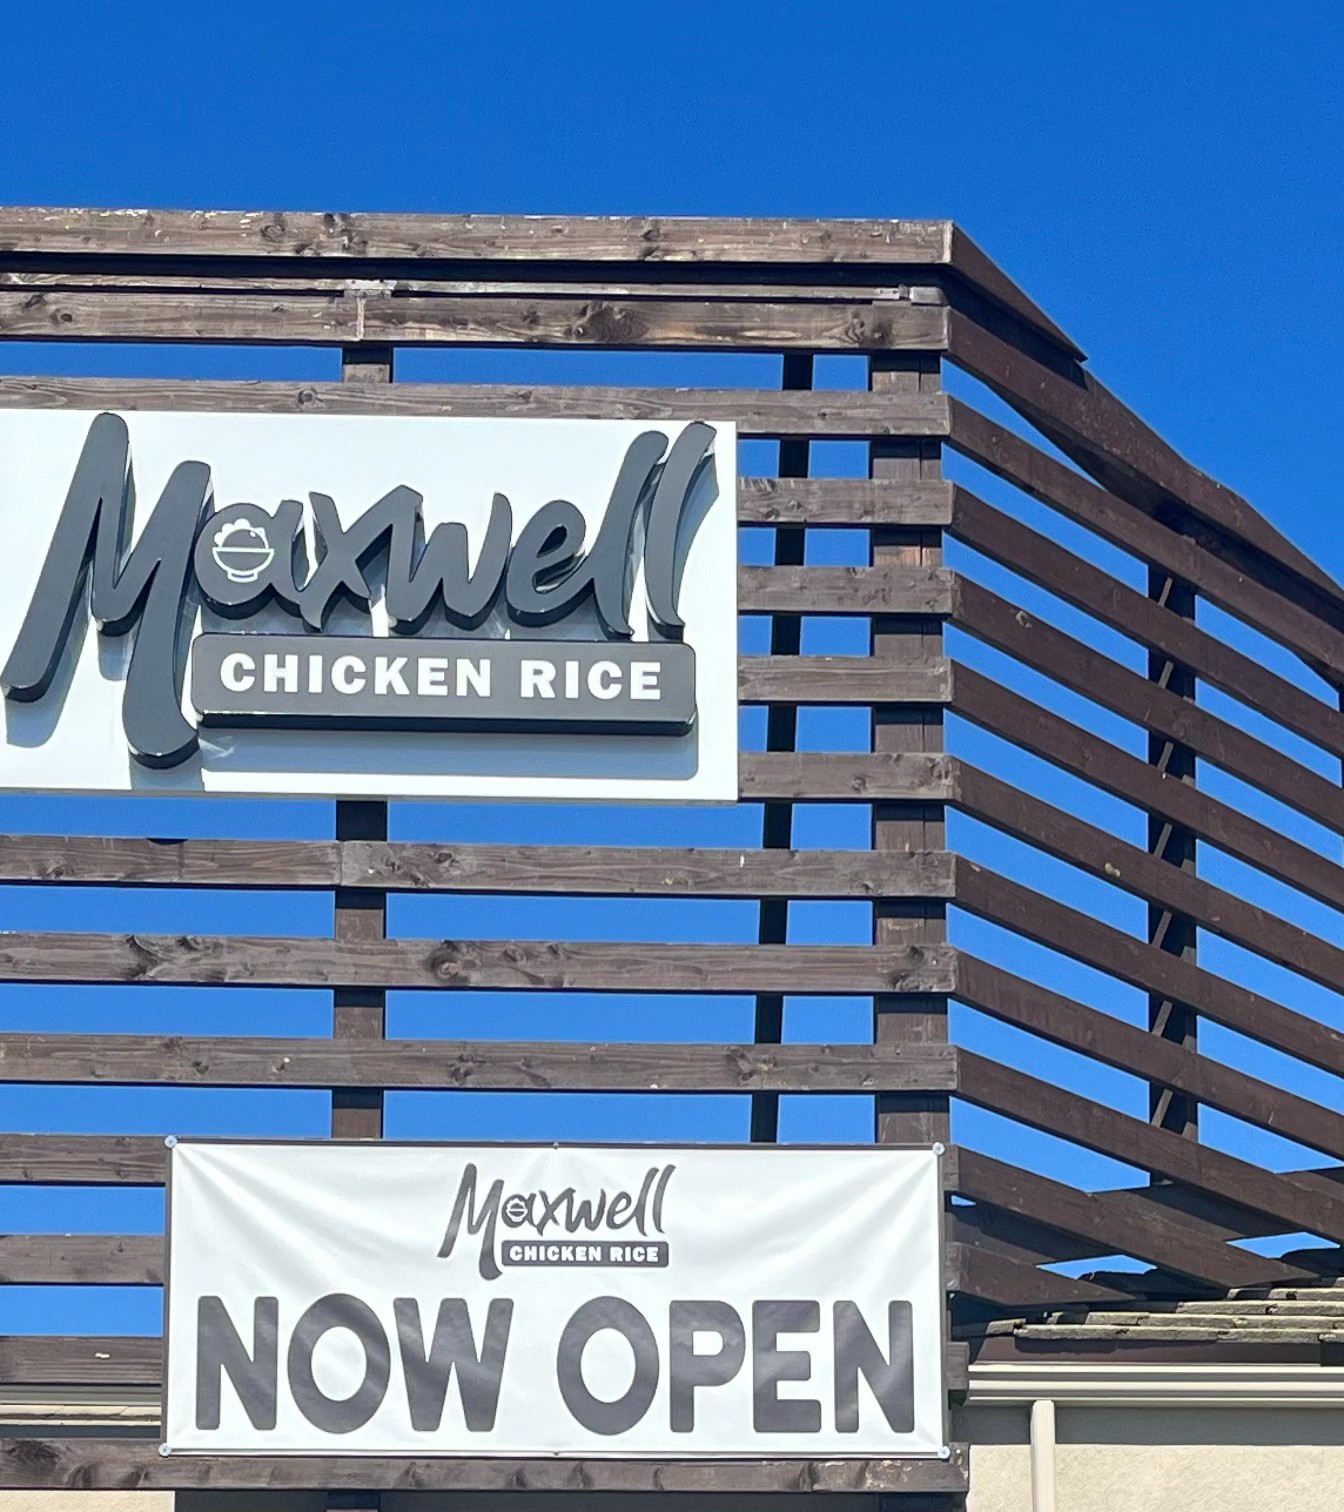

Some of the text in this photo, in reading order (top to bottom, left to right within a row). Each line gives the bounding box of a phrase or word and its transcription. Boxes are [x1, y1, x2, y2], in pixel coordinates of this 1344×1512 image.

[0, 411, 717, 768] Maxwell
[219, 651, 663, 701] CHICKEN RICE
[437, 1162, 676, 1281] Maxwell
[508, 1244, 660, 1263] CHICKEN RICE
[194, 1292, 915, 1437] NOW OPEN
